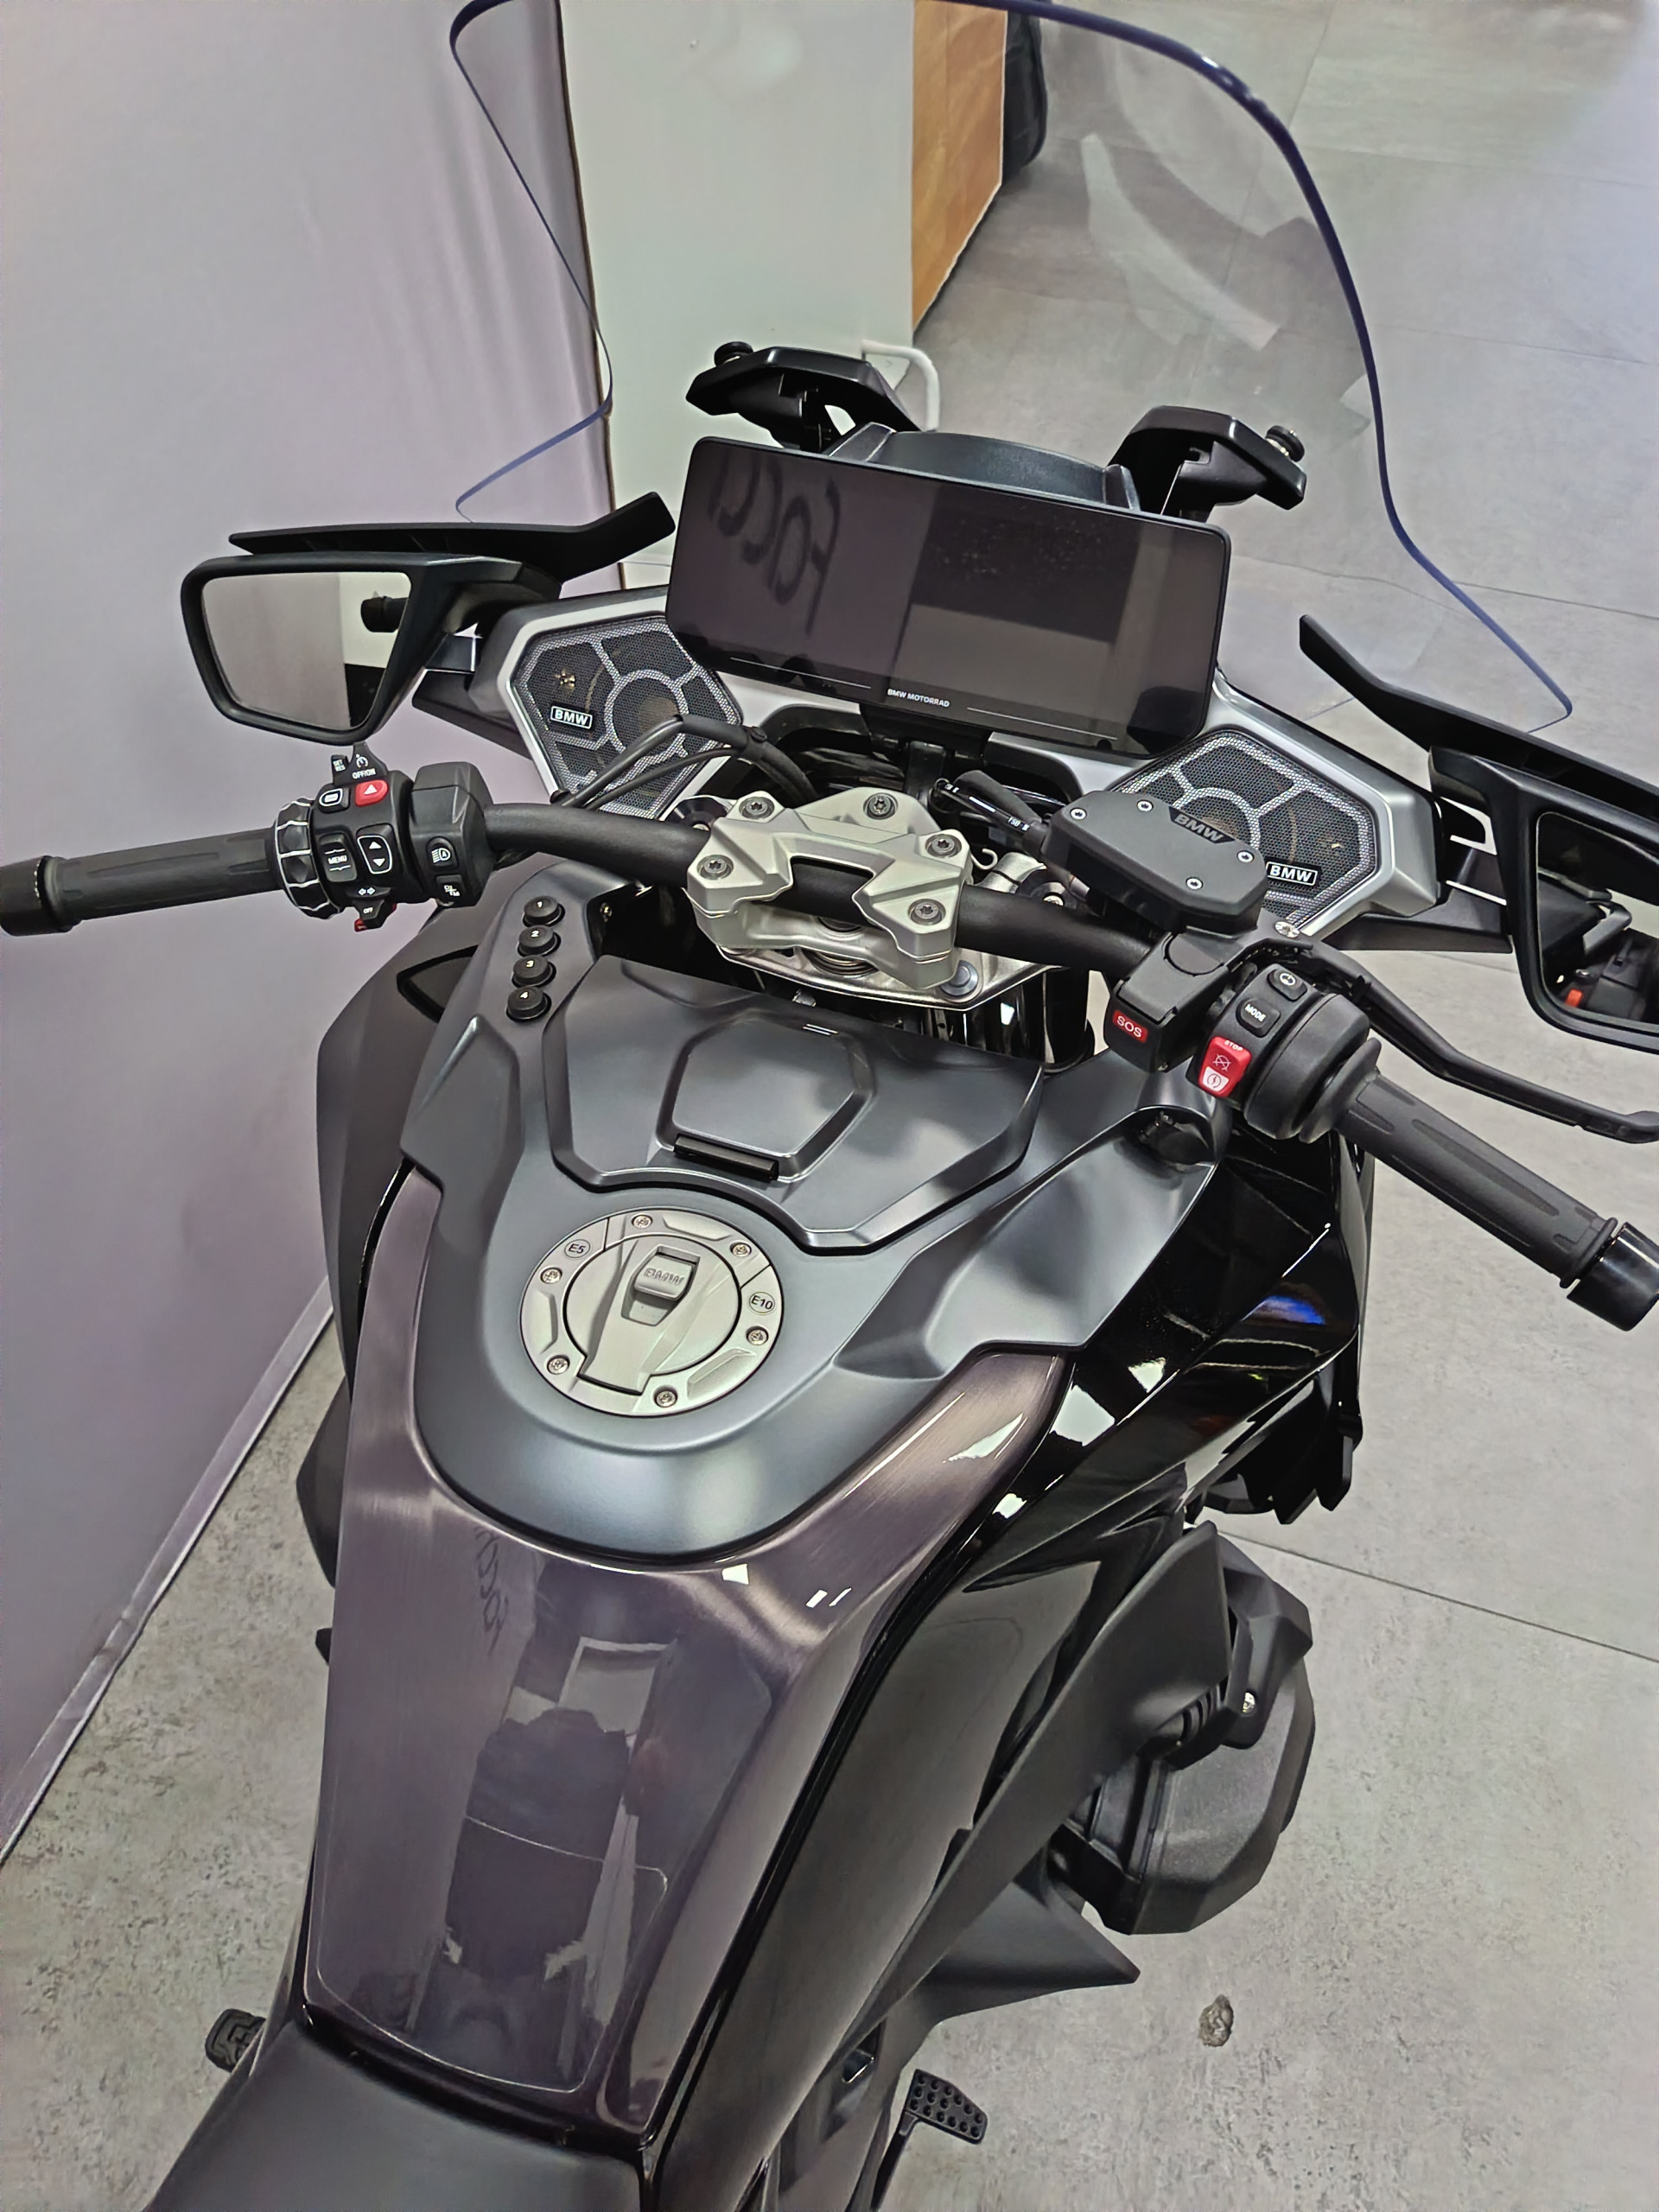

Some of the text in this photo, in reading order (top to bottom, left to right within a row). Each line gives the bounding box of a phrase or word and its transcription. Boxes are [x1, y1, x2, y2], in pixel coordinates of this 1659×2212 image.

[887, 689, 950, 708] BMW MOTORRAD
[555, 709, 588, 726] BMW
[1173, 814, 1224, 842] BMW
[1269, 864, 1313, 882] BMW
[1244, 1003, 1267, 1022] MODE
[1116, 1015, 1142, 1038] SOS
[1224, 1039, 1244, 1052] STOP
[568, 1243, 587, 1255] E5
[643, 1266, 685, 1286] BMW
[751, 1294, 774, 1312] E10
